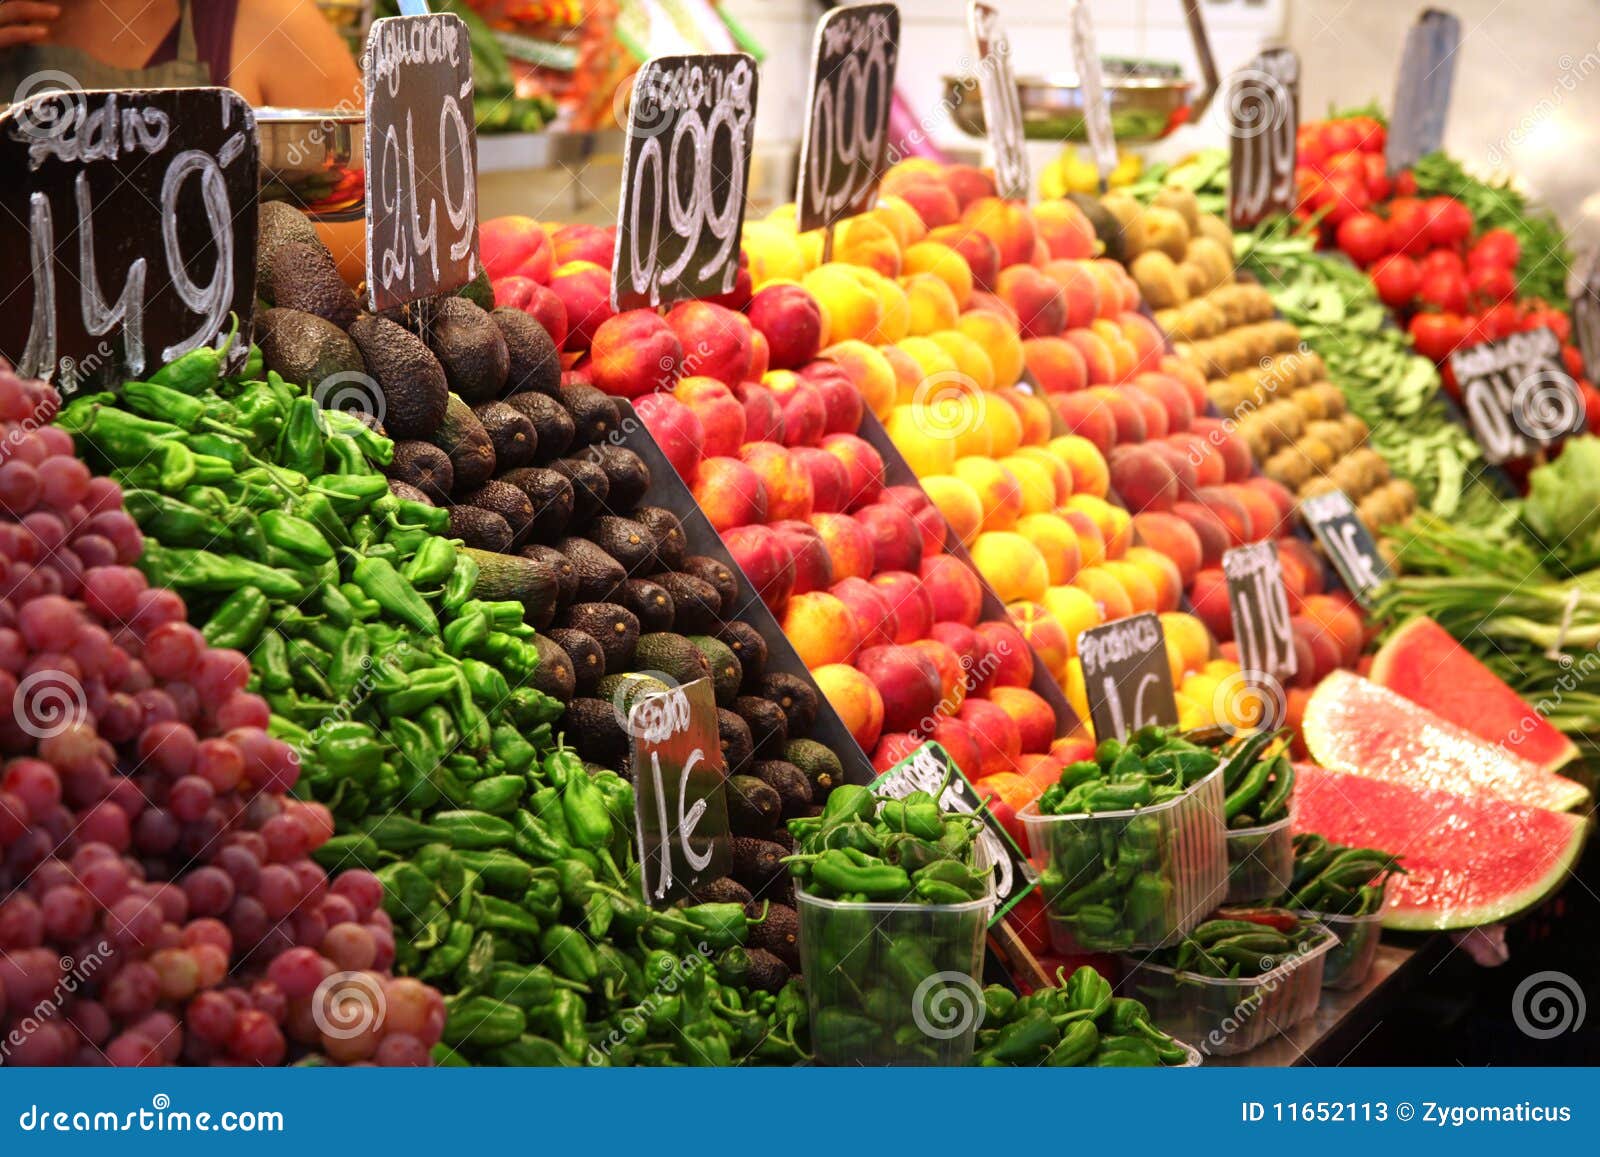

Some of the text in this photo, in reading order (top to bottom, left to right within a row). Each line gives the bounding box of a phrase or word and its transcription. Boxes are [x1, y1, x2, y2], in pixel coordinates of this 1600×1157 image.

[381, 95, 477, 292] 2,49
[630, 100, 744, 304] 0,99
[651, 748, 714, 898] 1€
